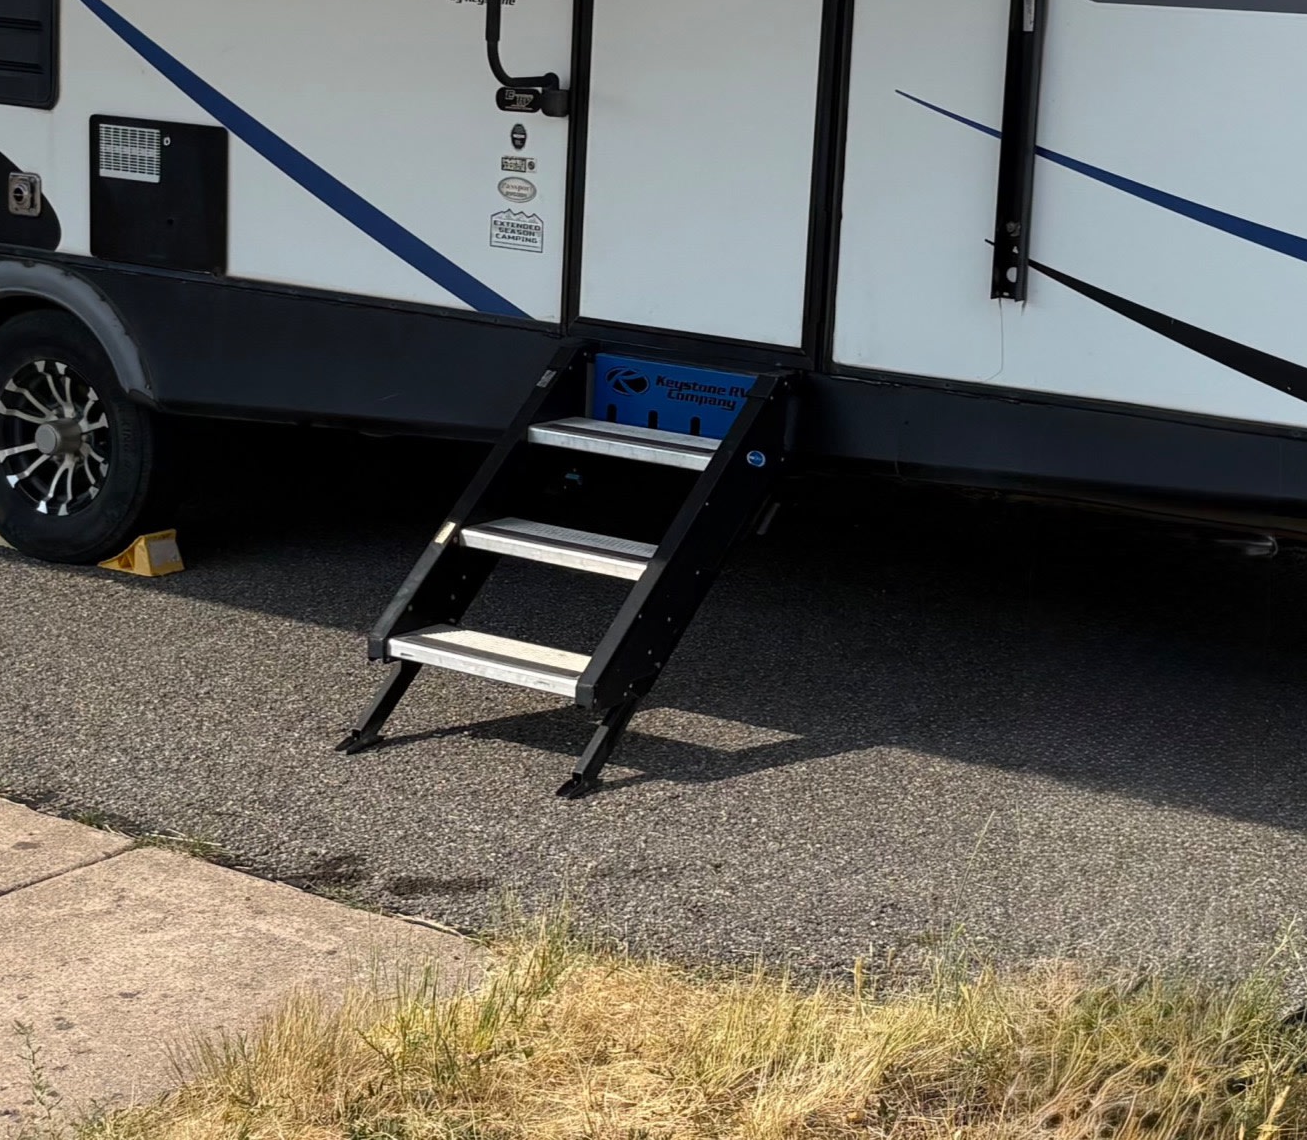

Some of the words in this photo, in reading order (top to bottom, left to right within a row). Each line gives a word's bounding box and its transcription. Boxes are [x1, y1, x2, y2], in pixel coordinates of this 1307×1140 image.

[493, 220, 541, 231] EXTENDED
[498, 227, 535, 237] SEASON
[495, 233, 538, 244] CAMPING
[655, 375, 727, 396] Keystone
[667, 388, 737, 411] Company
